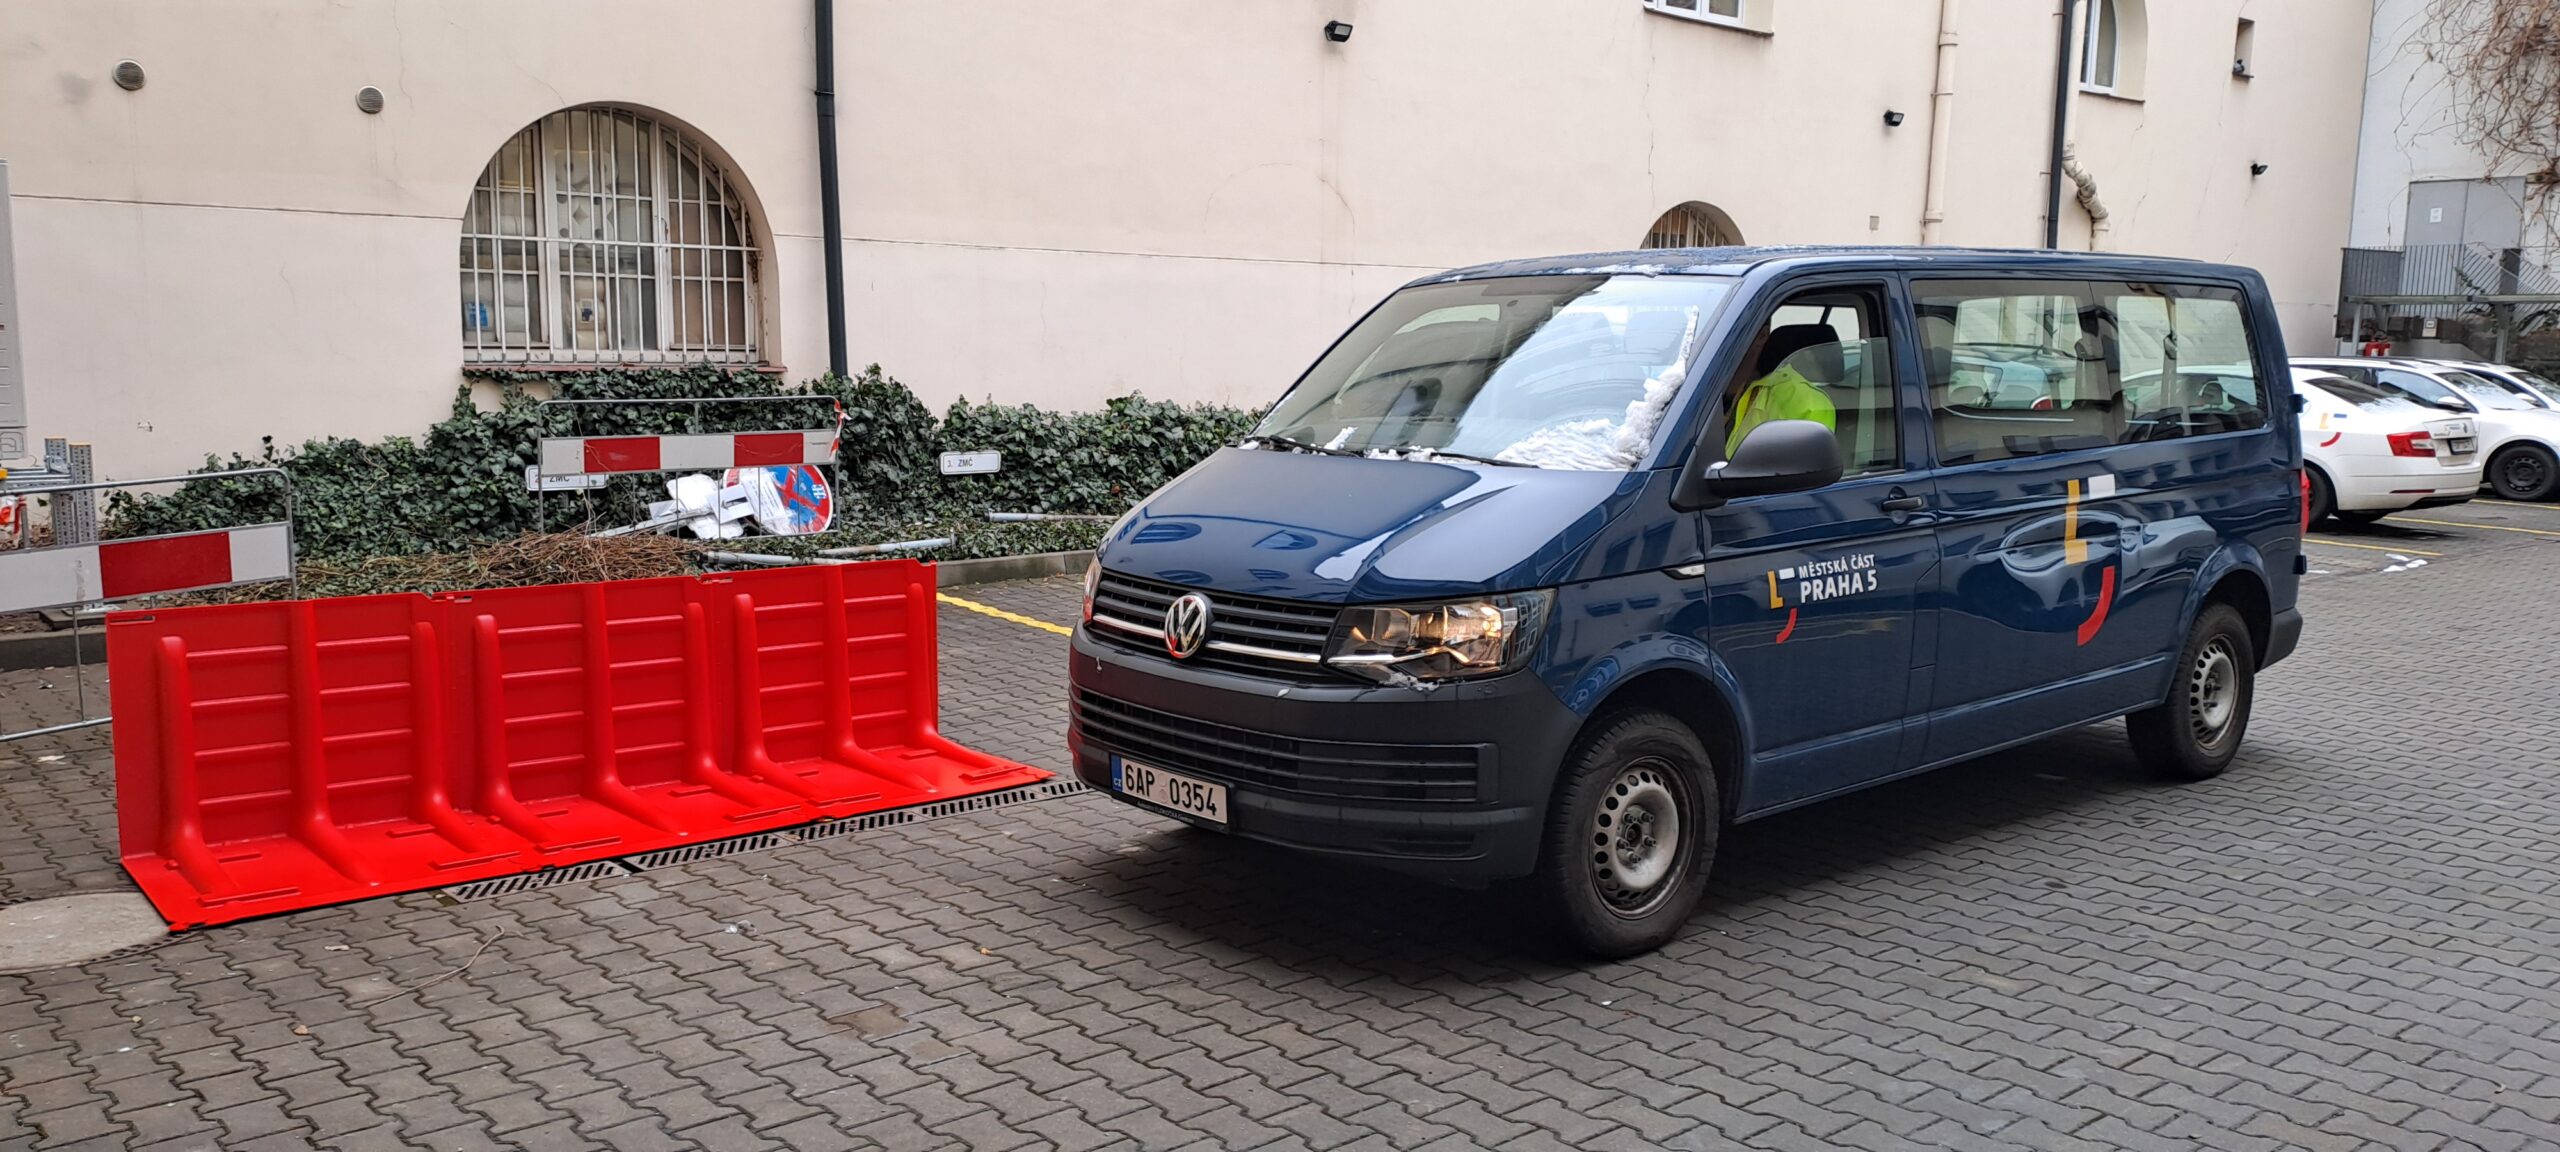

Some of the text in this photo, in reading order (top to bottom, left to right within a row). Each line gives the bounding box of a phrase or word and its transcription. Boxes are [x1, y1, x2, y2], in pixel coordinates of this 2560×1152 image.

[1798, 553, 1875, 579] MĚSTSKÁ ČÁST
[1800, 569, 1878, 604] PRAHA 5
[1165, 595, 1206, 658] VW
[1125, 764, 1155, 797] 6AP
[1169, 778, 1217, 816] 0354
